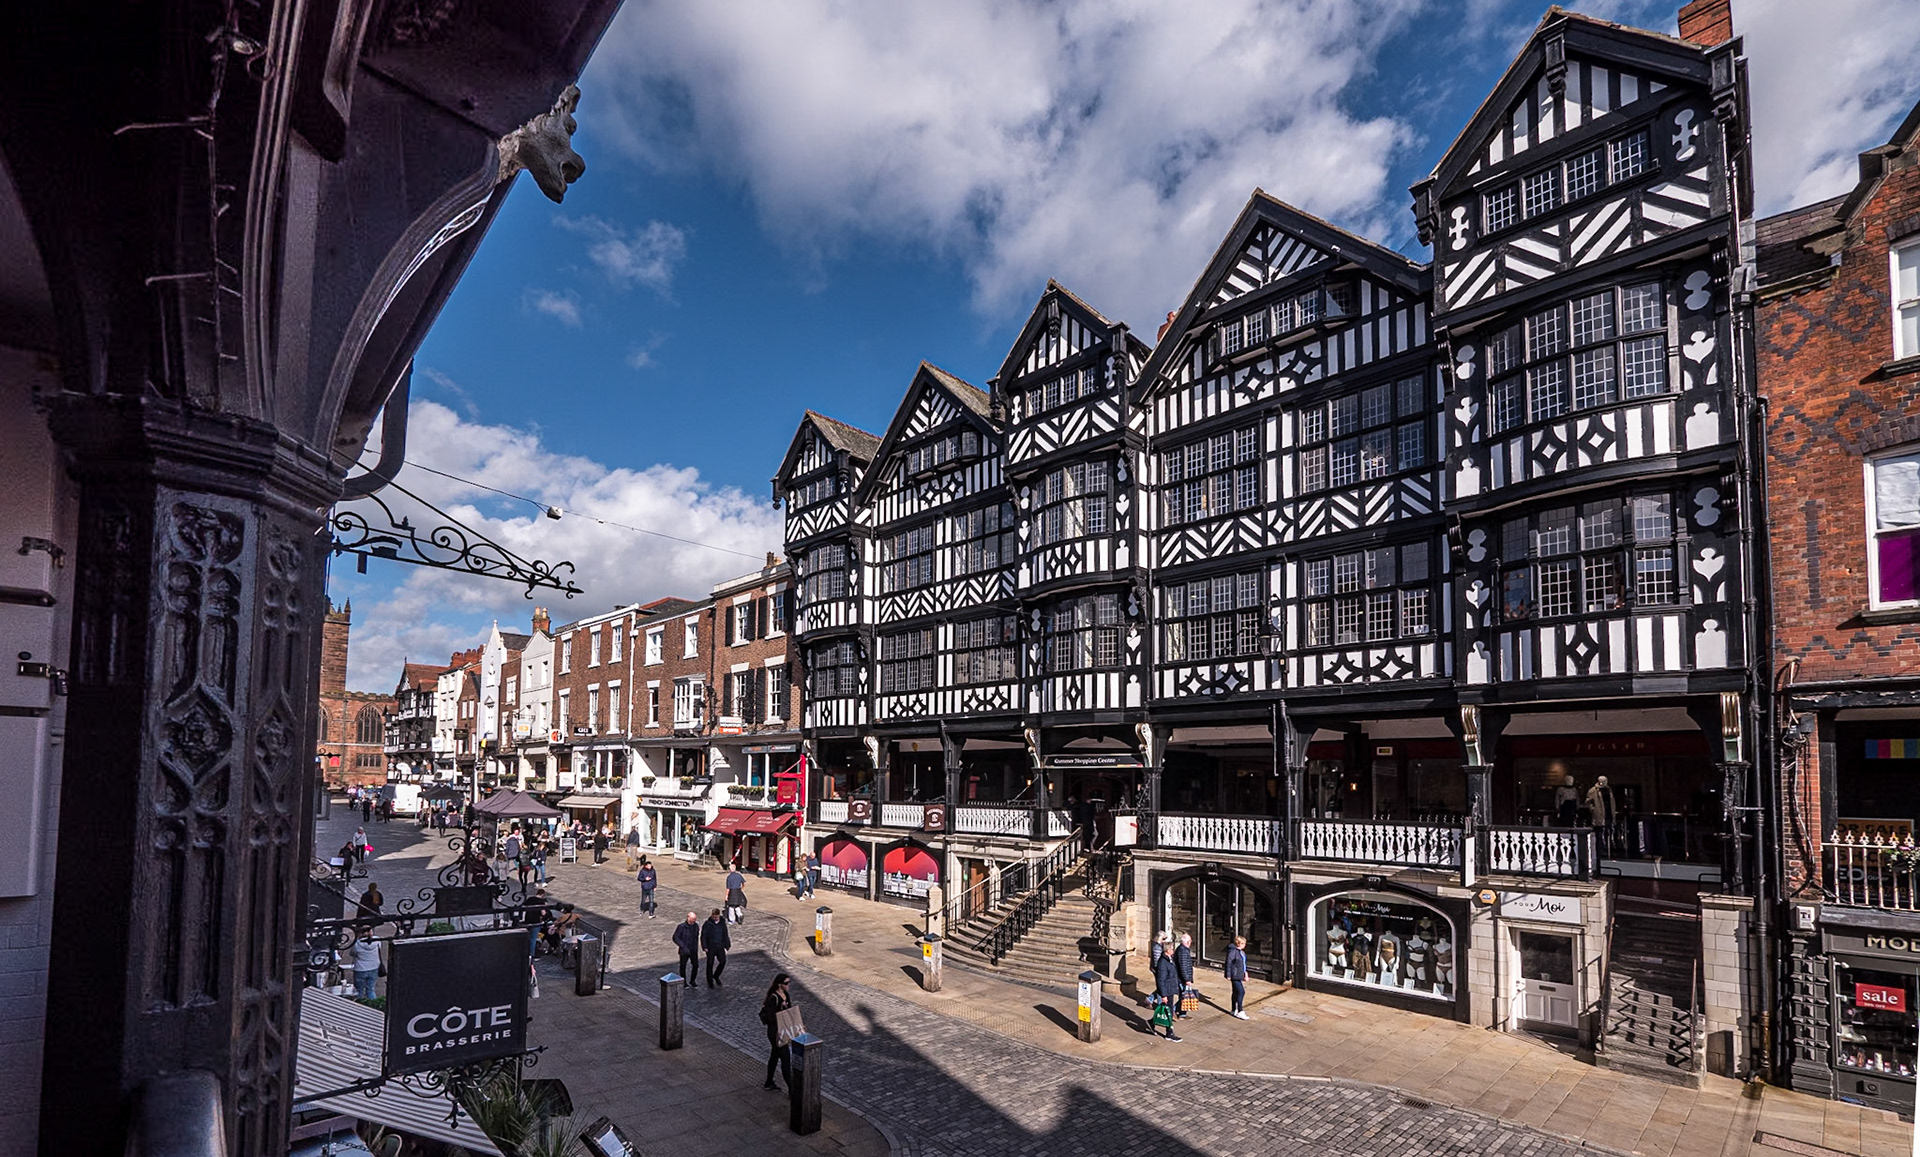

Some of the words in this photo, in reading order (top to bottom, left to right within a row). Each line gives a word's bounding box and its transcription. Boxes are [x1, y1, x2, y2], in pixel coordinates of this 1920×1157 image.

[1865, 824, 1908, 835] SALE
[1528, 897, 1566, 915] Moi
[1862, 990, 1898, 1004] sale
[406, 1003, 512, 1039] CÔTE
[405, 1029, 512, 1055] BRASSERIE
